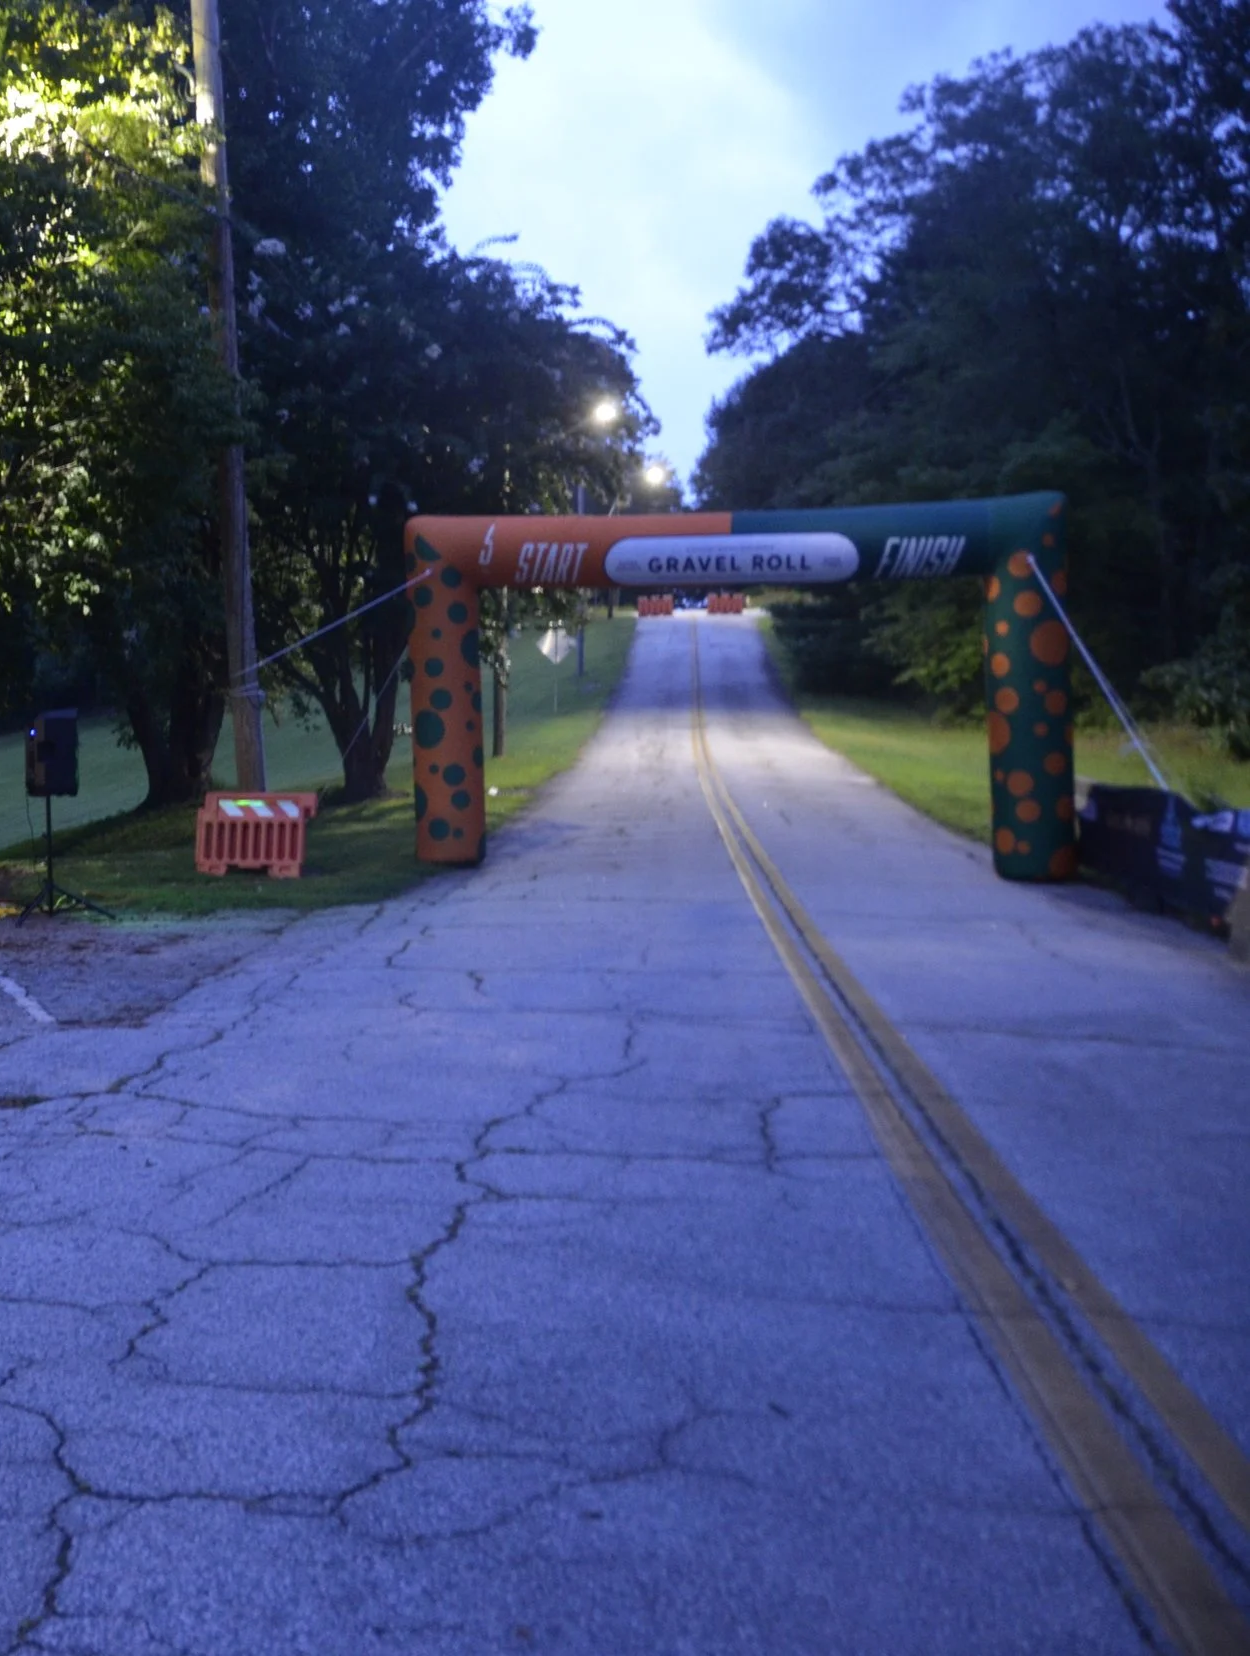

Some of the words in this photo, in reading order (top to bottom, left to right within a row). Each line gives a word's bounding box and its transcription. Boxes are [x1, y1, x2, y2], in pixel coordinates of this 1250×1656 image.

[515, 541, 589, 583] START
[647, 555, 742, 574] GRAVEL
[751, 553, 811, 571] ROLL
[873, 535, 966, 579] FINISH
